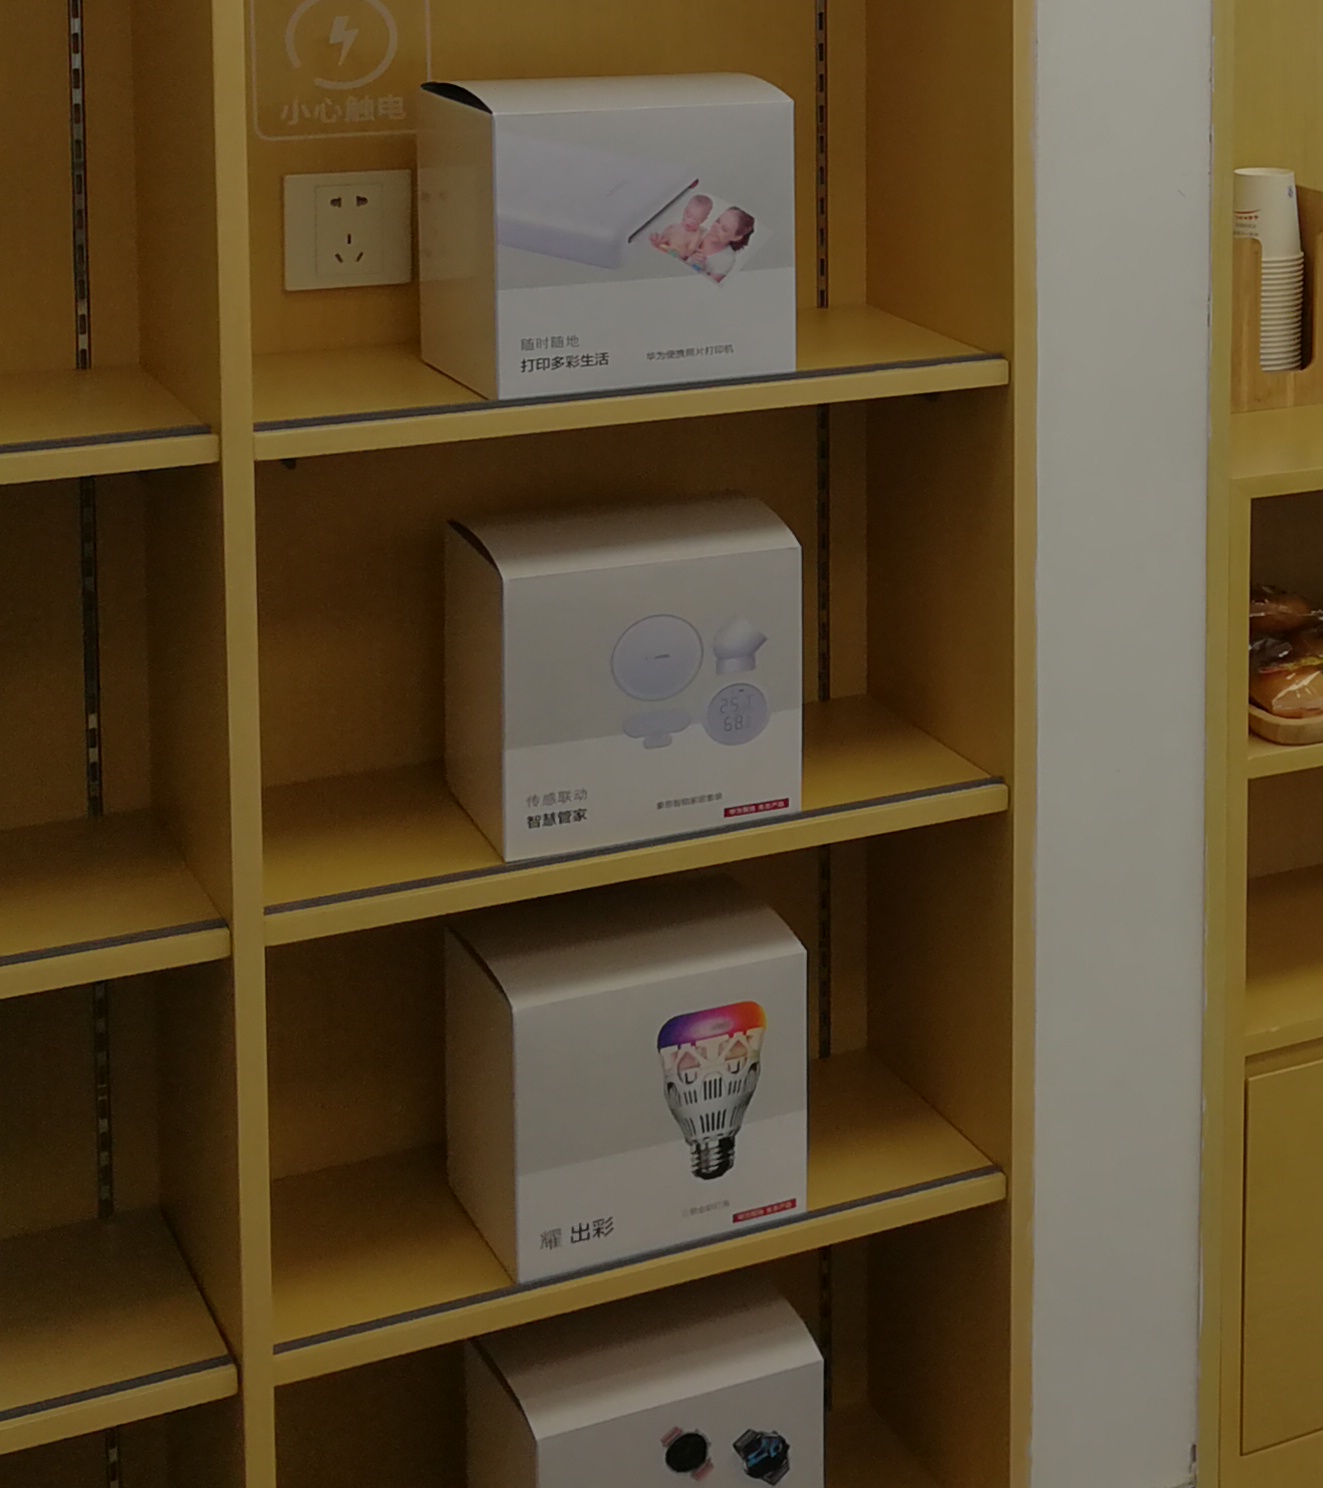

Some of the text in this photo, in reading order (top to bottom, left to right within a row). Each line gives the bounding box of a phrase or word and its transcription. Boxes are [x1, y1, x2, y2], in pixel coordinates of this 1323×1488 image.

[279, 92, 407, 127] 小心触电
[520, 334, 581, 352] 随时随地
[646, 343, 734, 362] 华为便携照片打印机
[520, 351, 610, 374] 打印多彩生活
[525, 788, 588, 809] 传感联动
[526, 807, 588, 830] 智慧管家
[570, 1215, 616, 1245] 出彩
